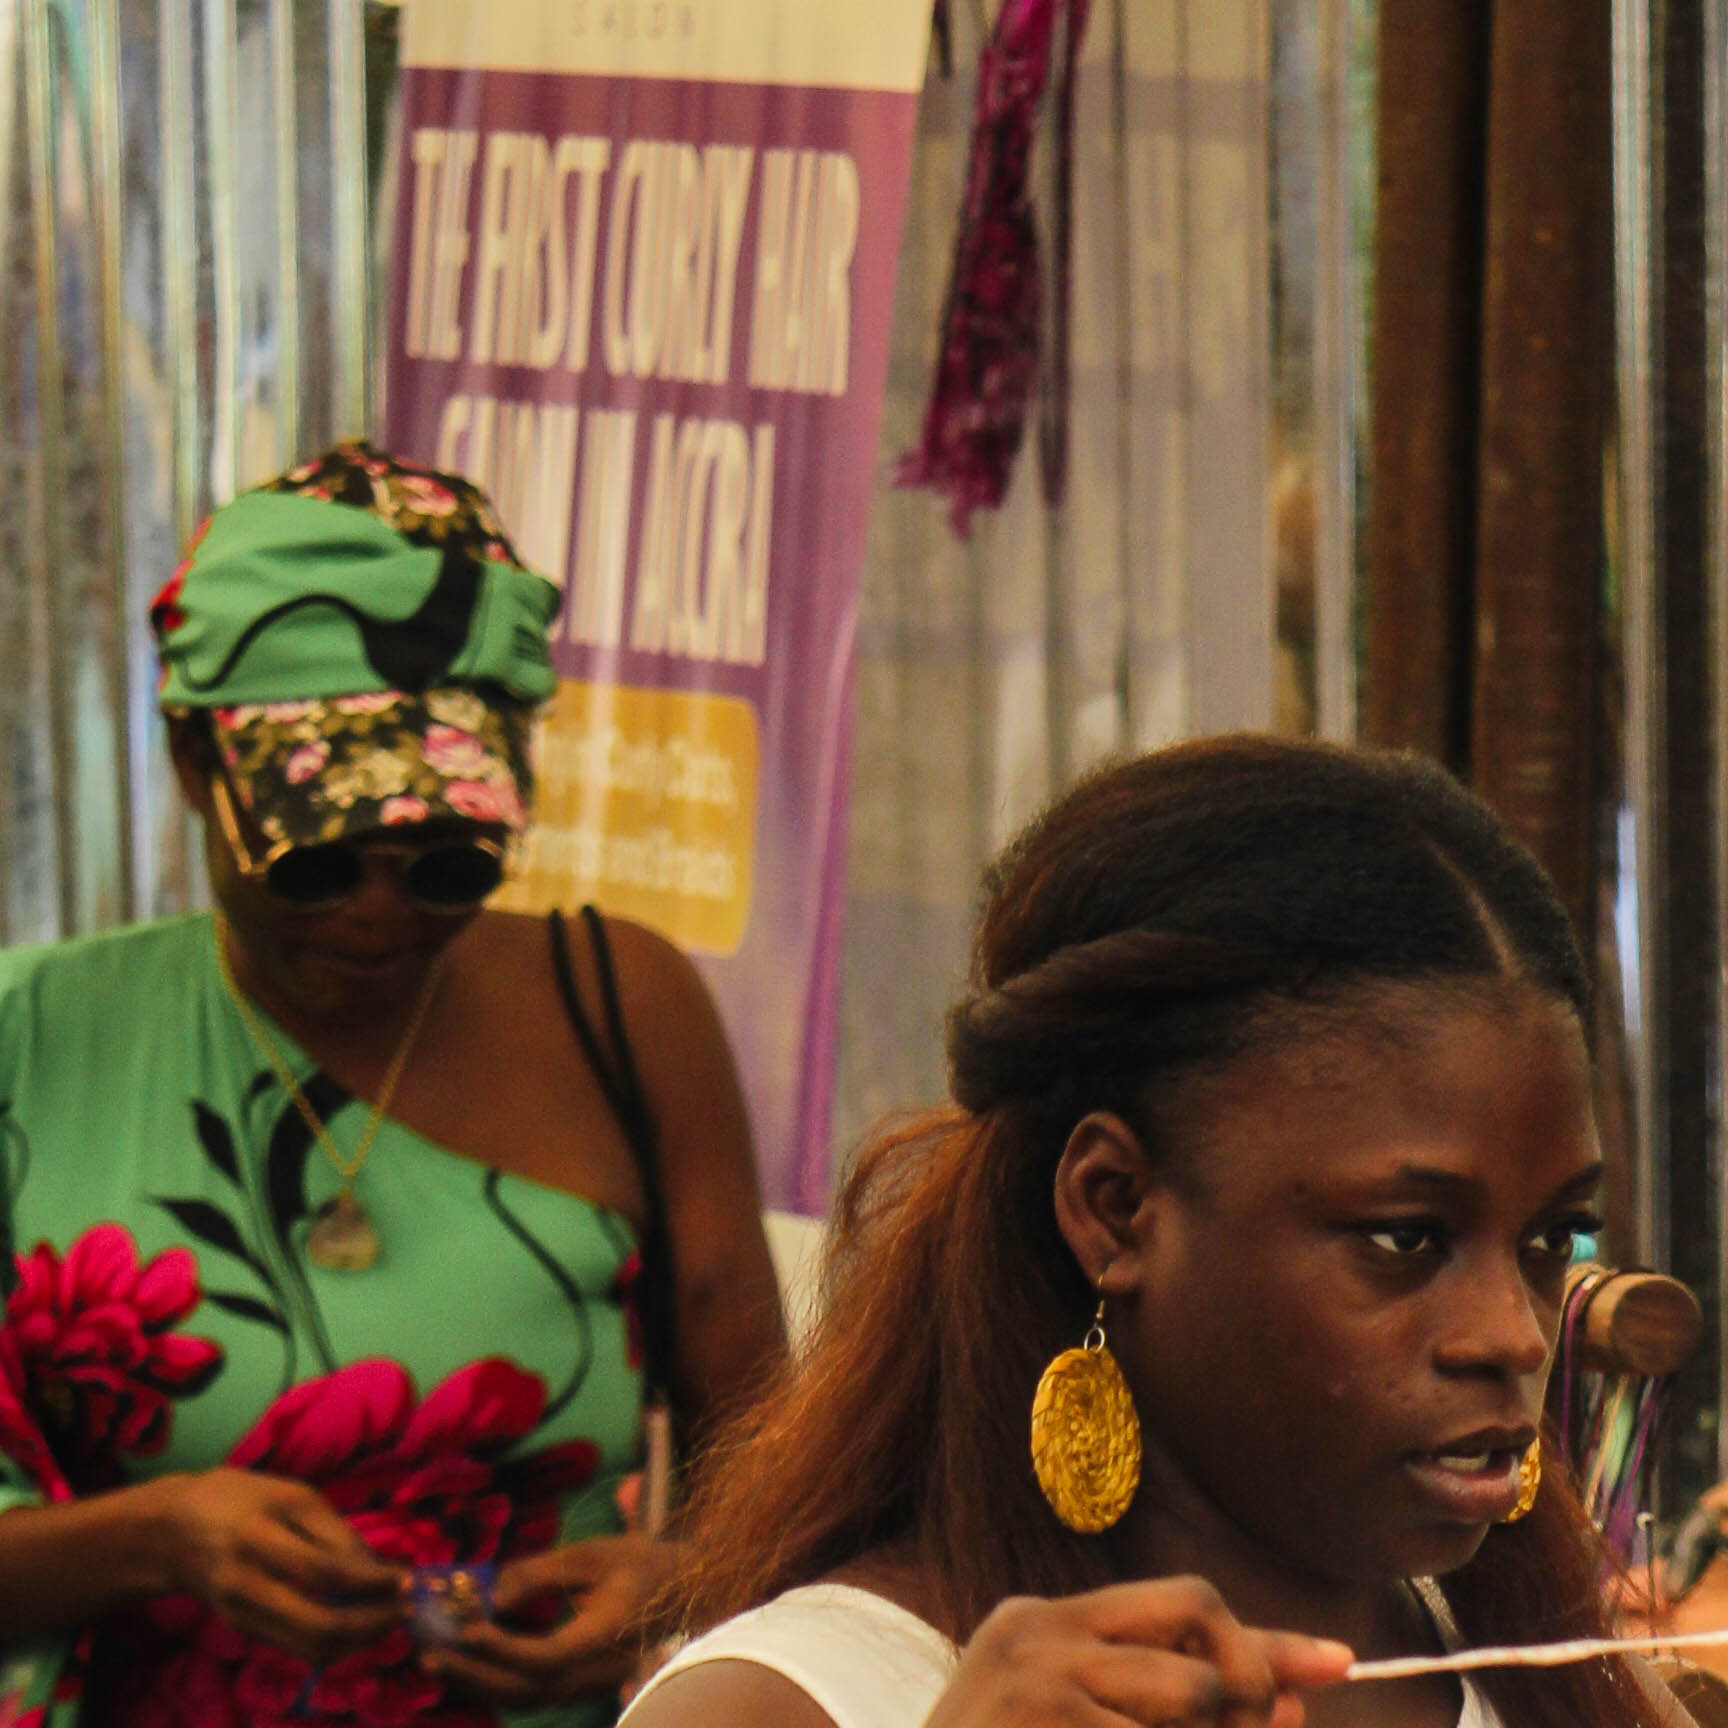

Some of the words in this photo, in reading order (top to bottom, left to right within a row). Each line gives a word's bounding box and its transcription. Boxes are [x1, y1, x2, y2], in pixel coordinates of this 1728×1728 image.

[405, 126, 479, 362] THE
[470, 130, 612, 374] FIRST
[603, 138, 755, 388] CURLY
[747, 148, 861, 398] HAIR
[568, 408, 638, 648] IN
